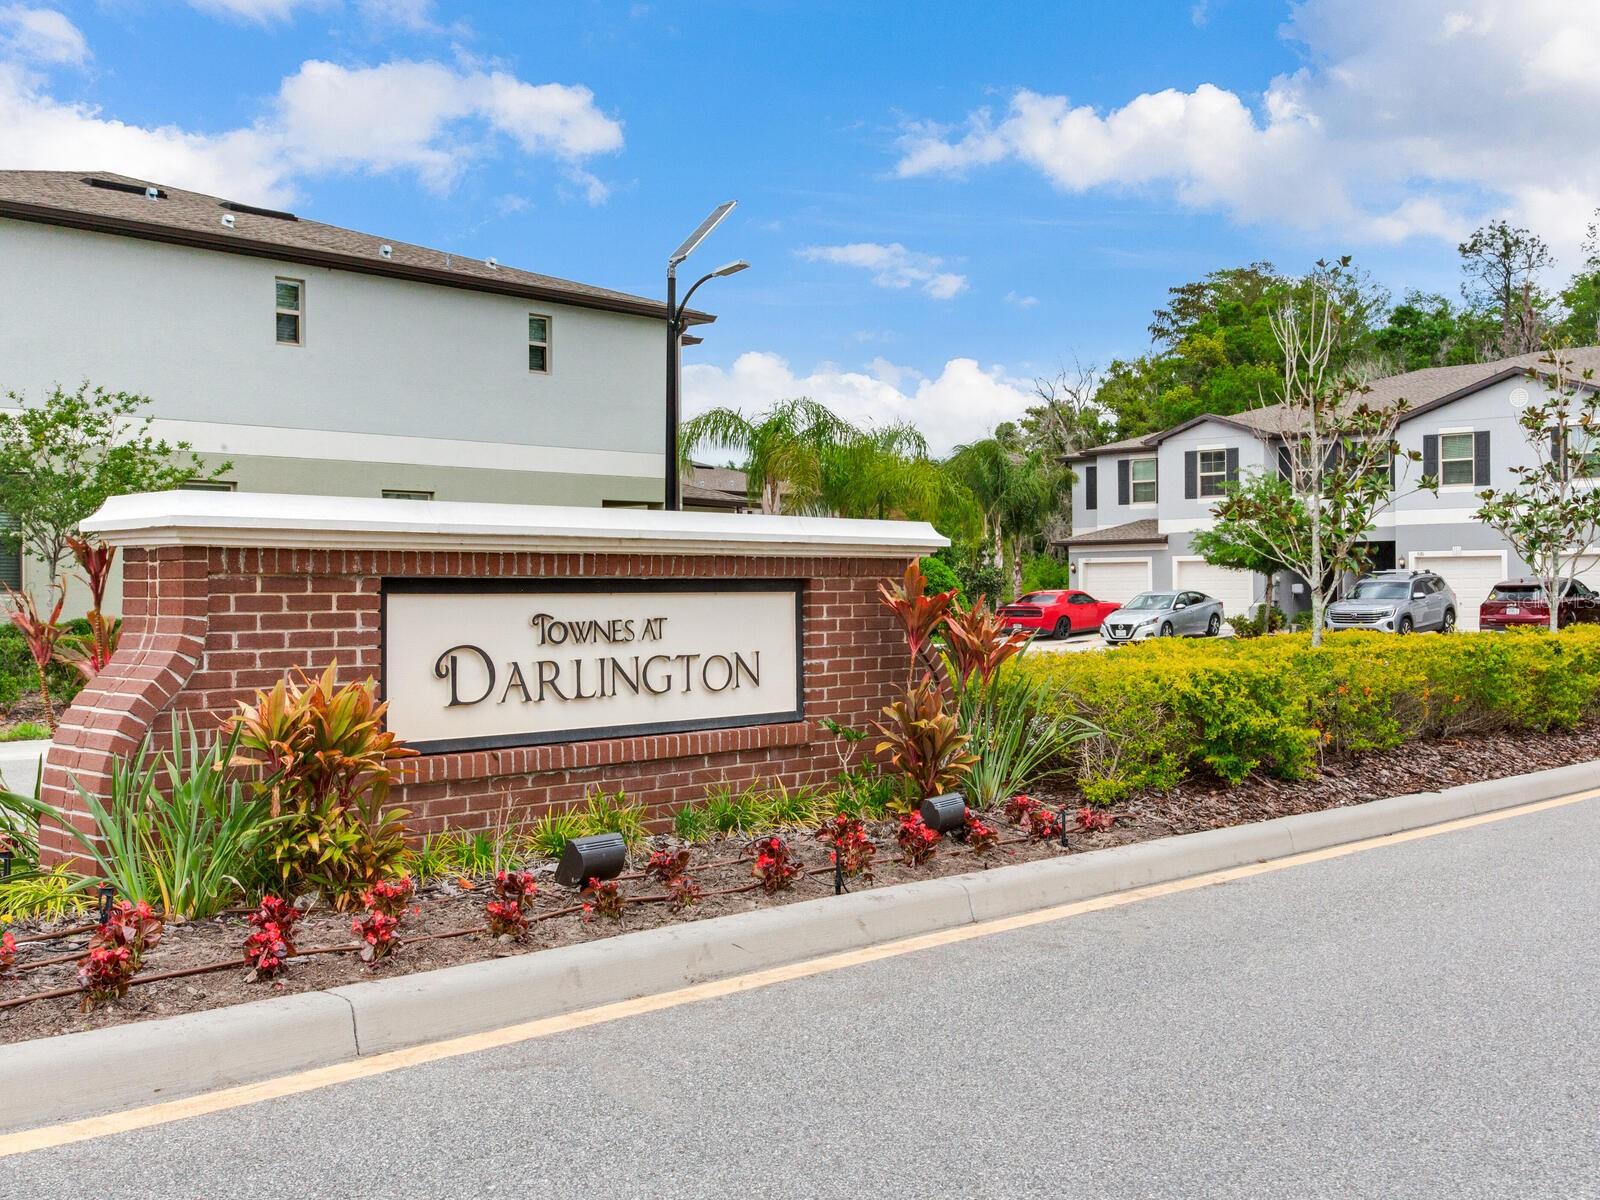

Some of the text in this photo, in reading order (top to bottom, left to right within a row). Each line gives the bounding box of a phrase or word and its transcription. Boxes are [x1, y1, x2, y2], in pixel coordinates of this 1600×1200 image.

[531, 613, 668, 646] TOWNES AT
[434, 644, 761, 708] DARLINGTON
